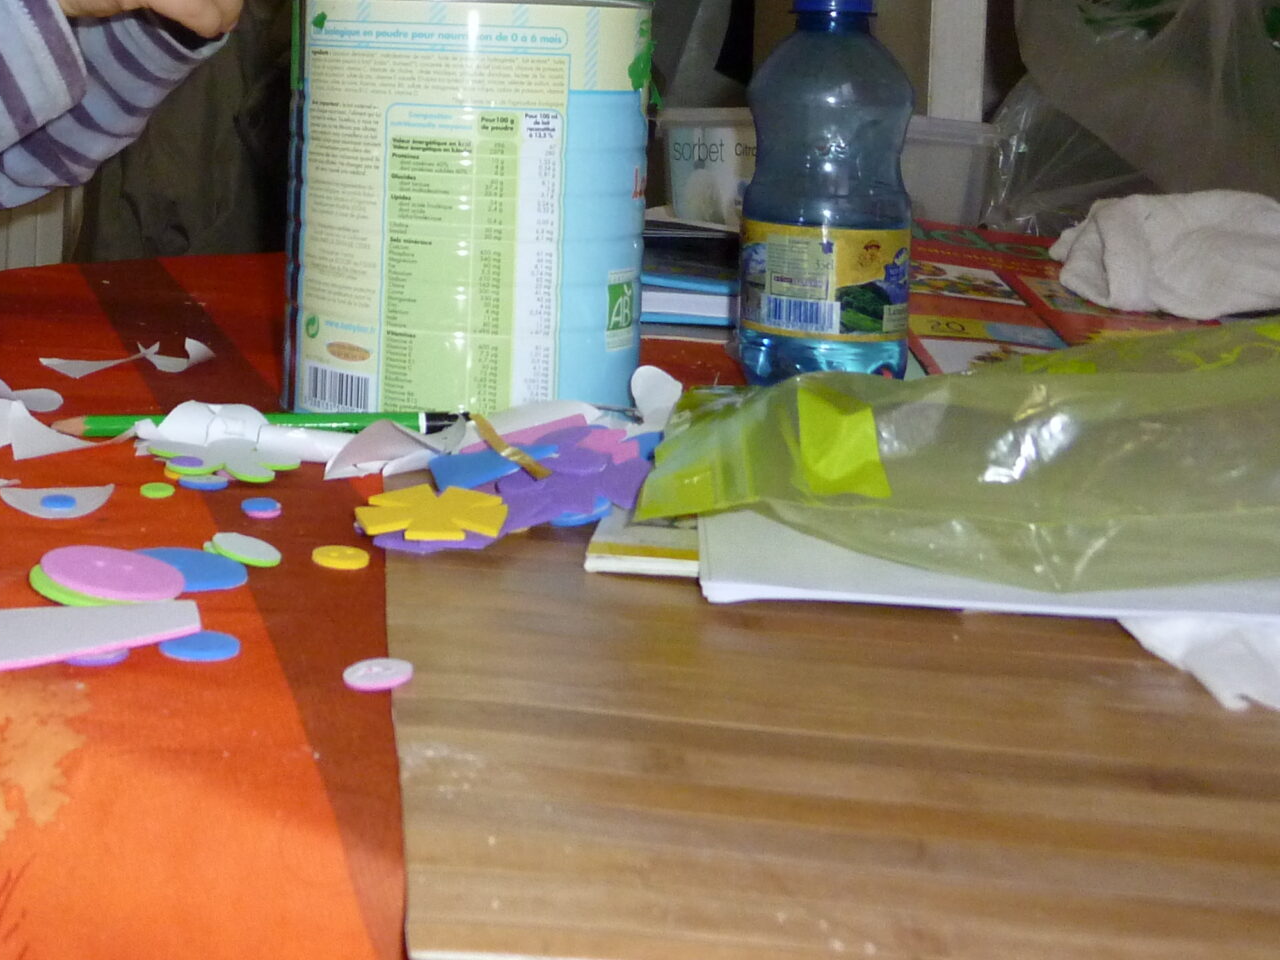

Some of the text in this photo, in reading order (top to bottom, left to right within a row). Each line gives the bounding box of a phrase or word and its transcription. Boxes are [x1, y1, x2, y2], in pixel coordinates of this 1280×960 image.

[363, 29, 373, 37] en
[376, 28, 409, 39] poudre
[411, 31, 433, 41] pour
[495, 31, 508, 41] de
[540, 33, 562, 44] mois
[480, 116, 495, 124] Pour
[496, 116, 509, 124] 100
[490, 124, 514, 132] poudre
[671, 137, 725, 163] sorbet
[609, 295, 632, 330] AB
